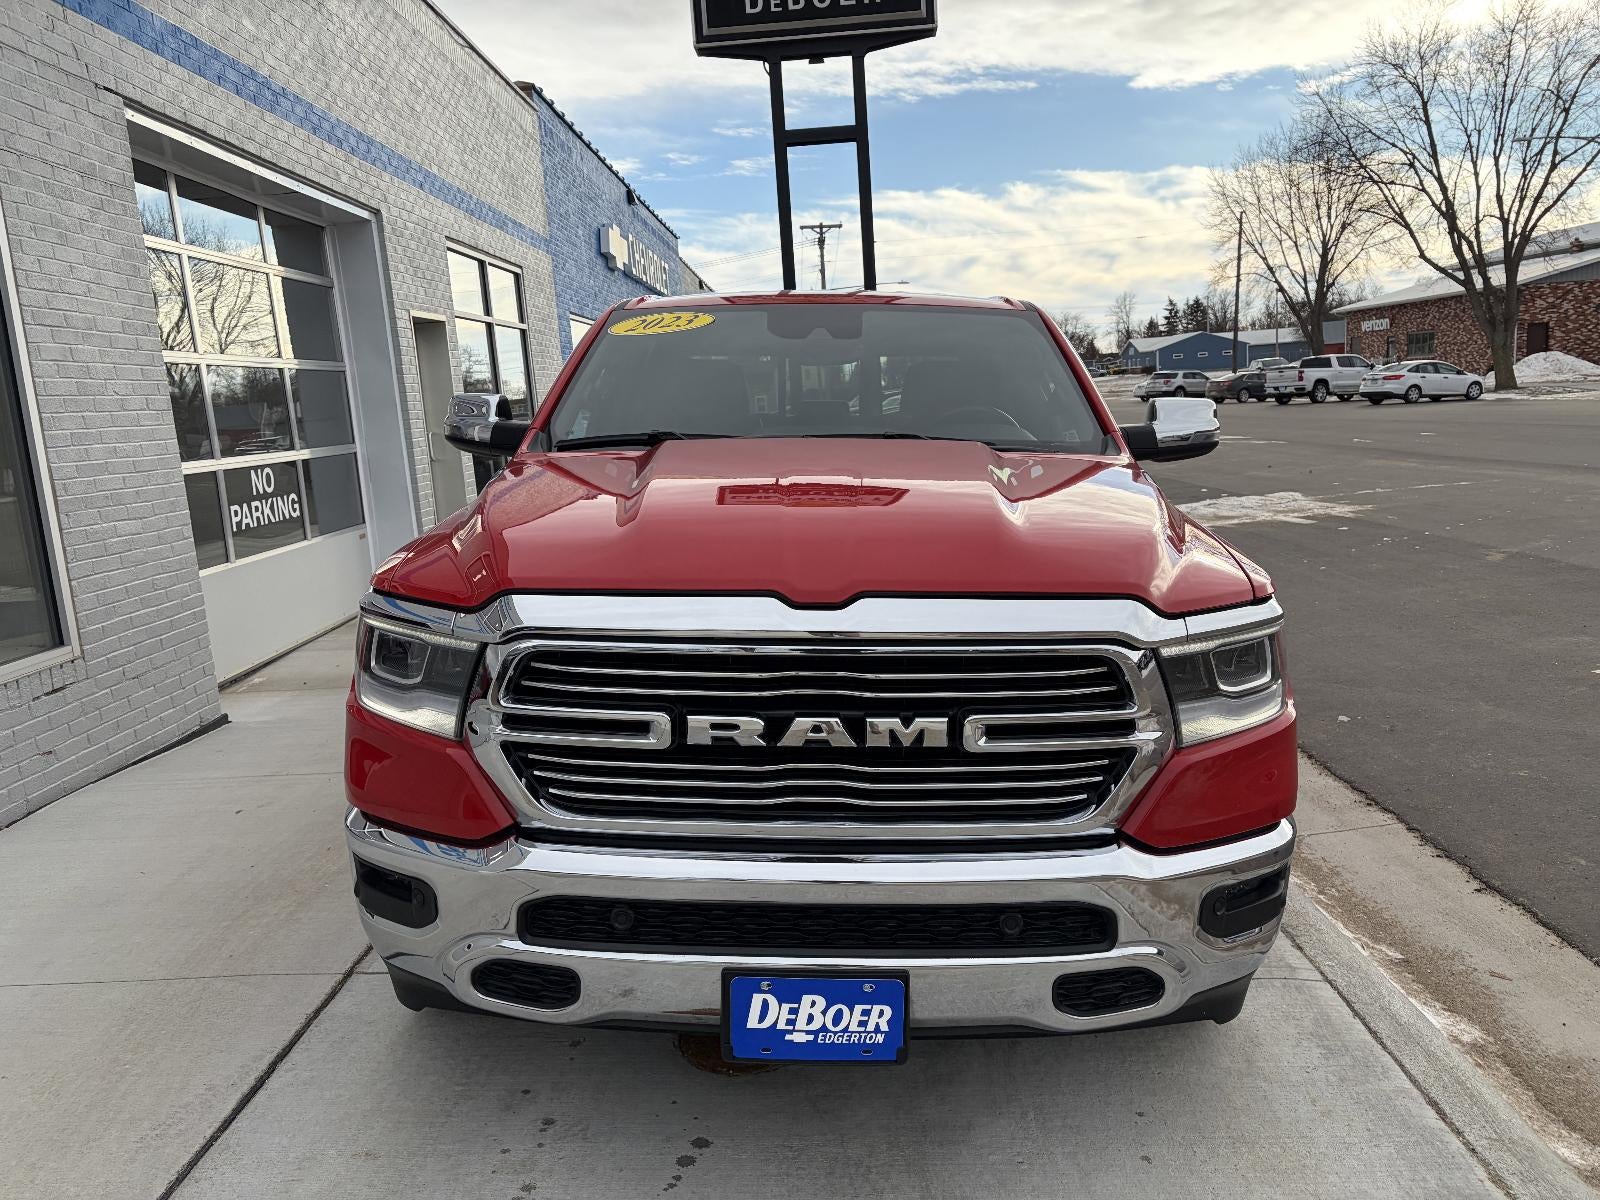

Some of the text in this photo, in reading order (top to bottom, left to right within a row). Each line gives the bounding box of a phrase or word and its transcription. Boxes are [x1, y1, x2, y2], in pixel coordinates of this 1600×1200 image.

[624, 315, 699, 332] 2023
[1361, 318, 1390, 331] verizon
[250, 467, 275, 495] NO
[229, 493, 300, 532] PARKING
[686, 715, 949, 747] RAM
[817, 1032, 885, 1044] EDGERTON
